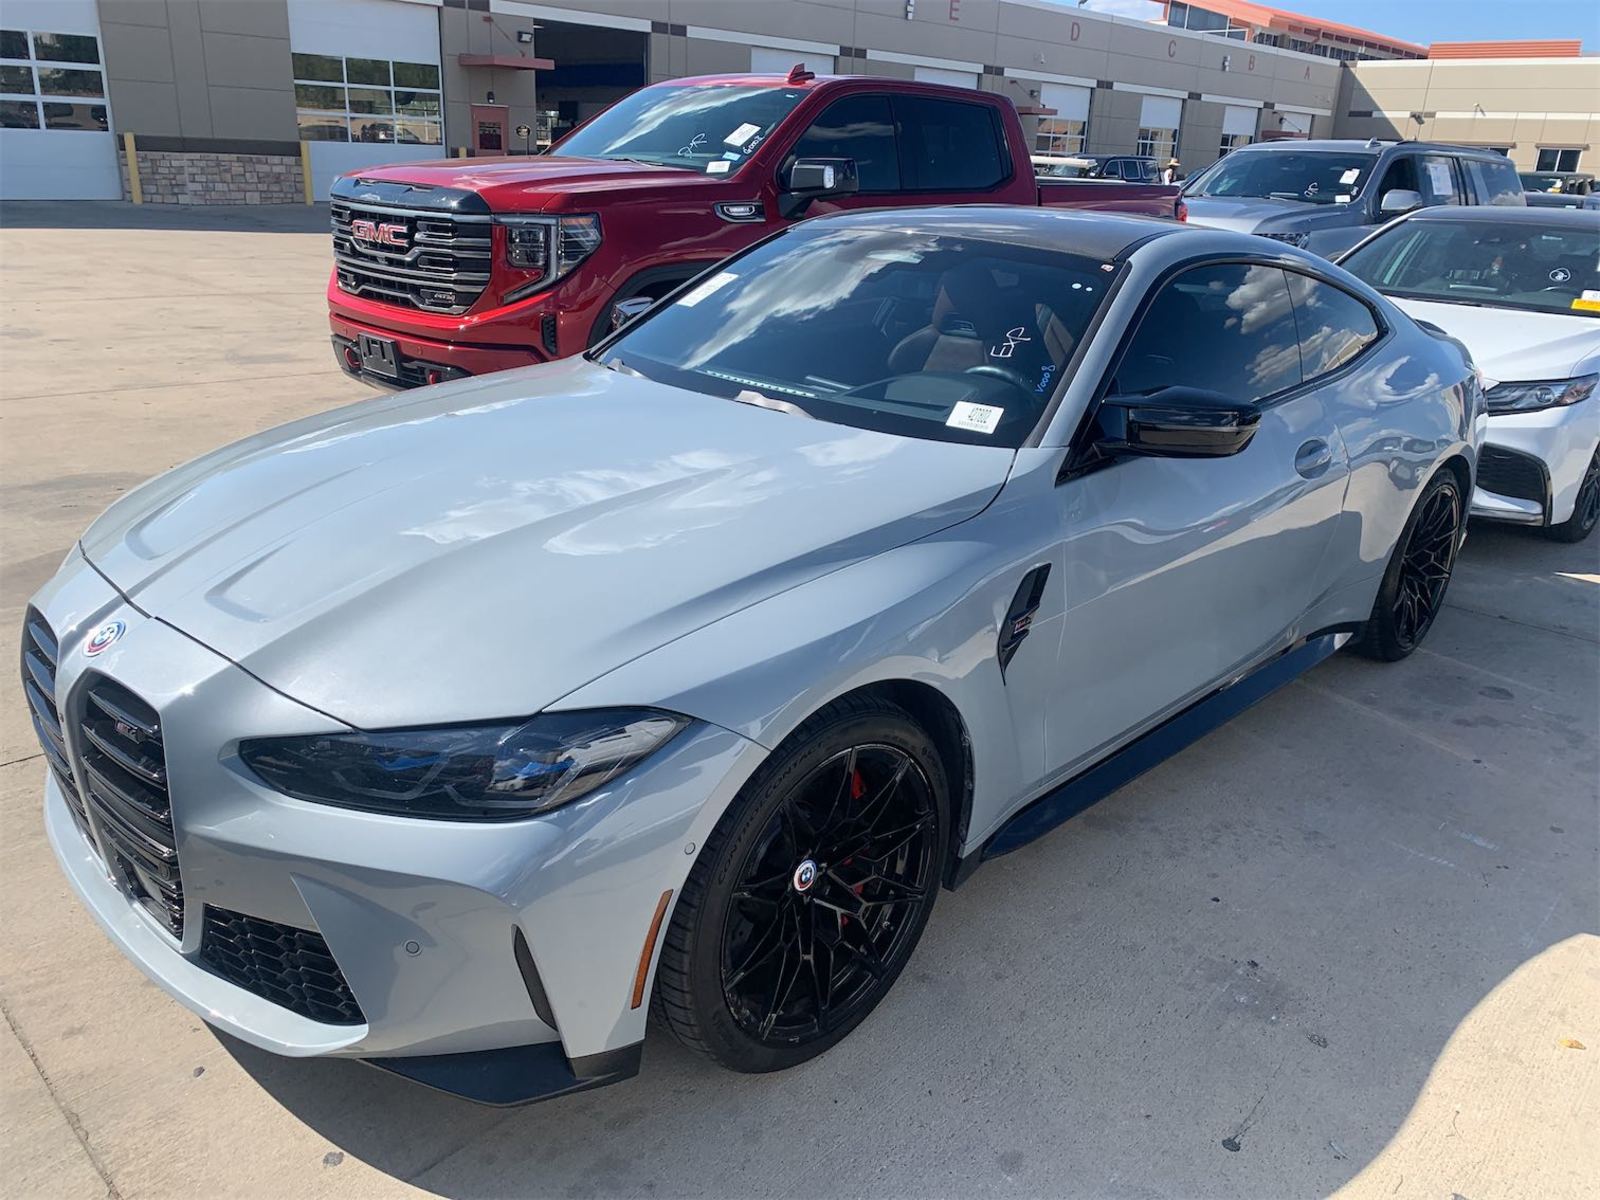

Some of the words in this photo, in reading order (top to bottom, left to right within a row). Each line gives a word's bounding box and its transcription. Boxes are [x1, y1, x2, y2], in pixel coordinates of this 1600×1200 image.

[949, 0, 960, 21] E
[1071, 22, 1081, 41] D
[1168, 40, 1176, 57] C
[1249, 55, 1255, 71] B
[1304, 66, 1311, 80] A
[352, 220, 408, 247] GMC
